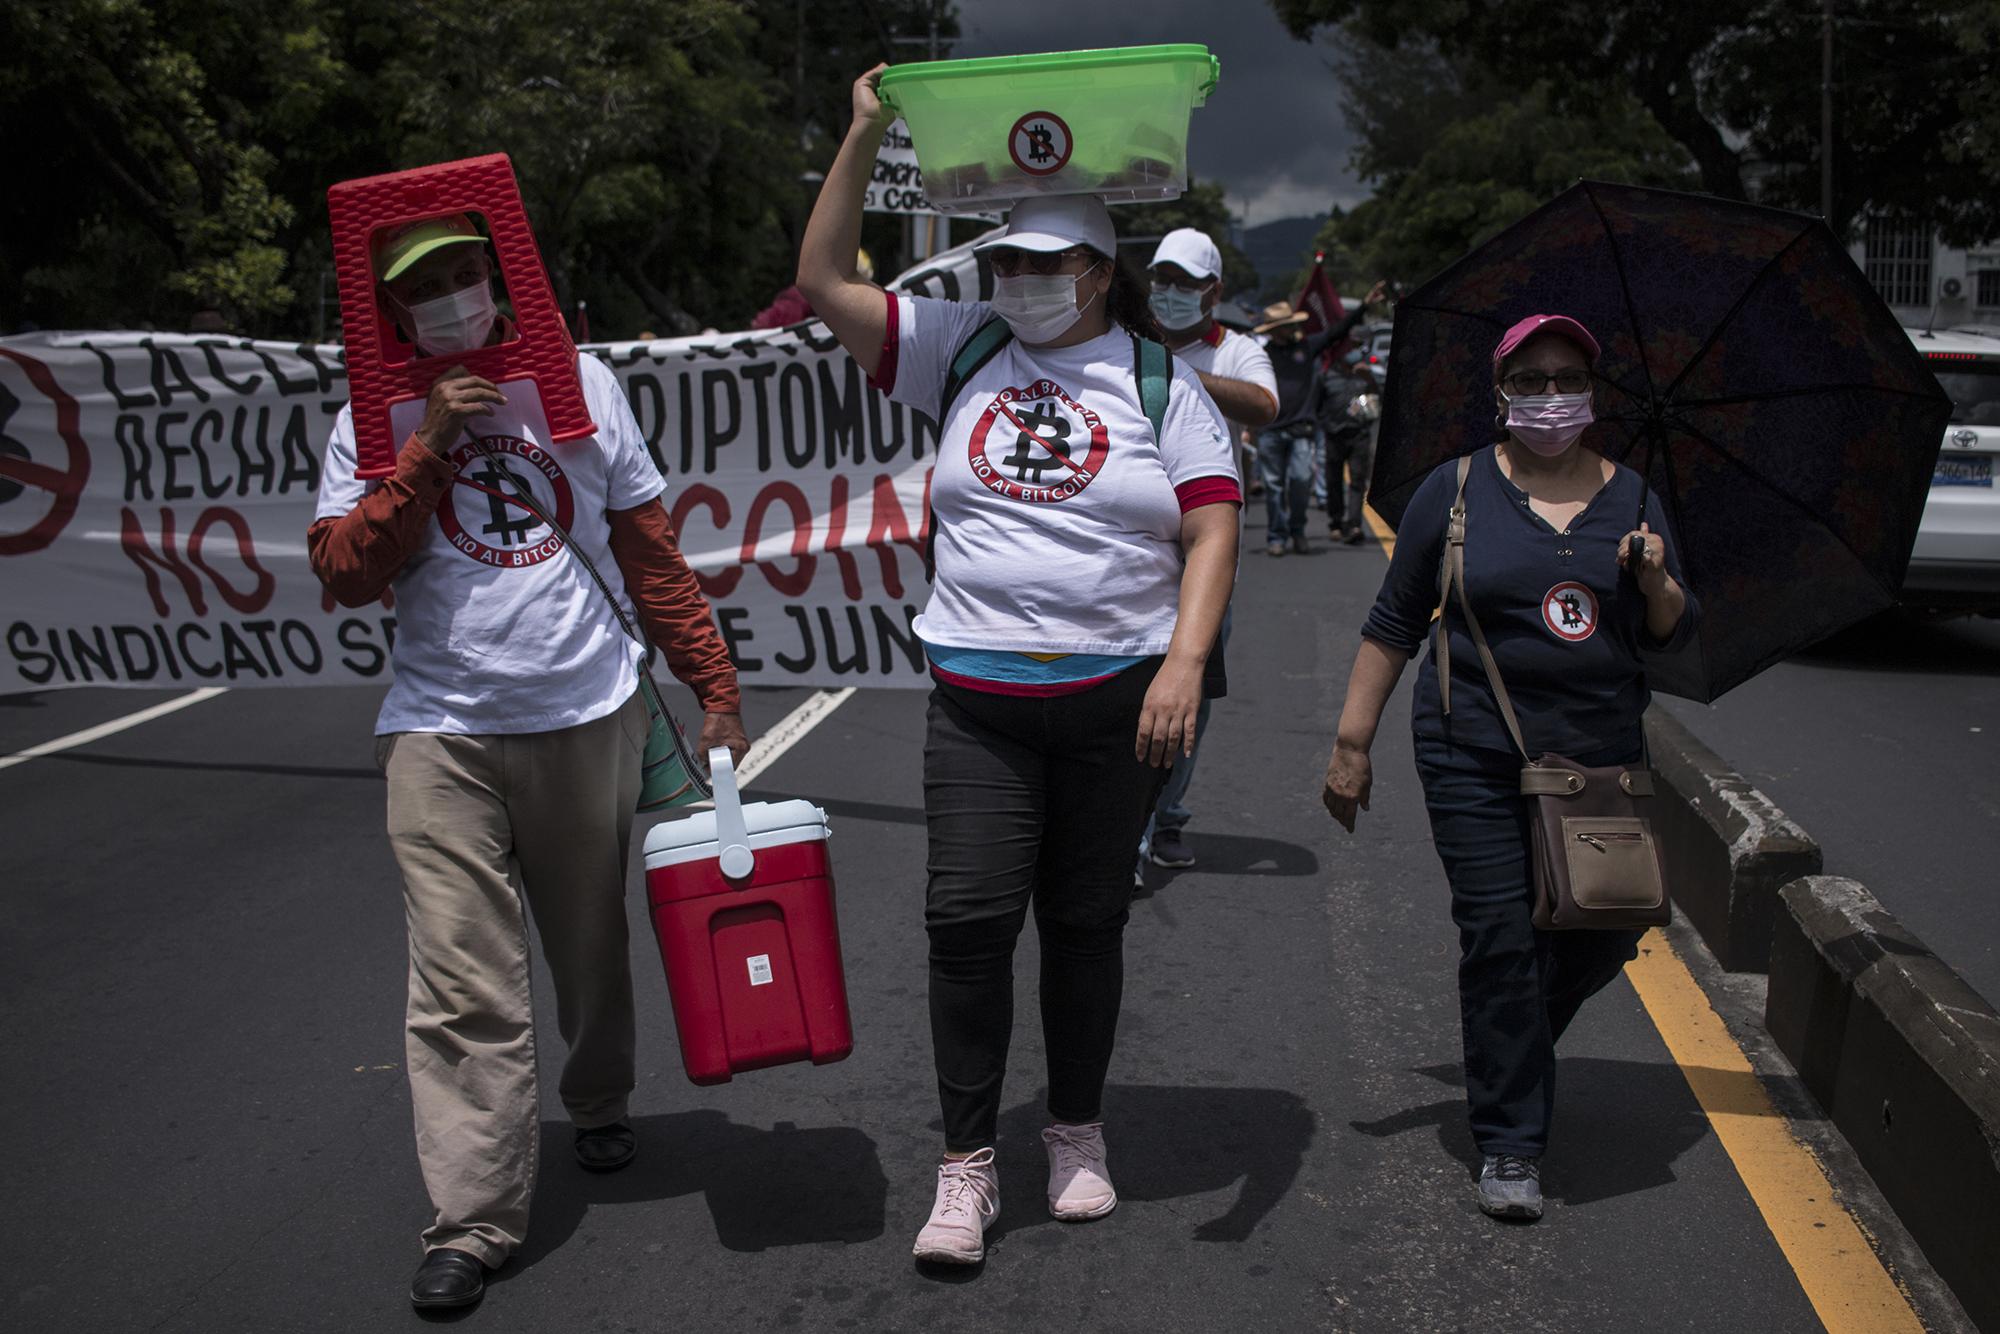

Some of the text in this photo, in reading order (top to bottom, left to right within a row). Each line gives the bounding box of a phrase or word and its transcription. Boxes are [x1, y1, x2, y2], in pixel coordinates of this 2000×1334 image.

[989, 381, 1101, 430] NO AL BITCOIN
[116, 400, 348, 502] RECHA
[486, 437, 562, 480] BITCOIN
[971, 454, 1093, 501] NO AL BITCOIN
[119, 505, 276, 618] NO
[453, 532, 563, 566] NO AL BITCOI
[7, 618, 323, 683] SINDICATO
